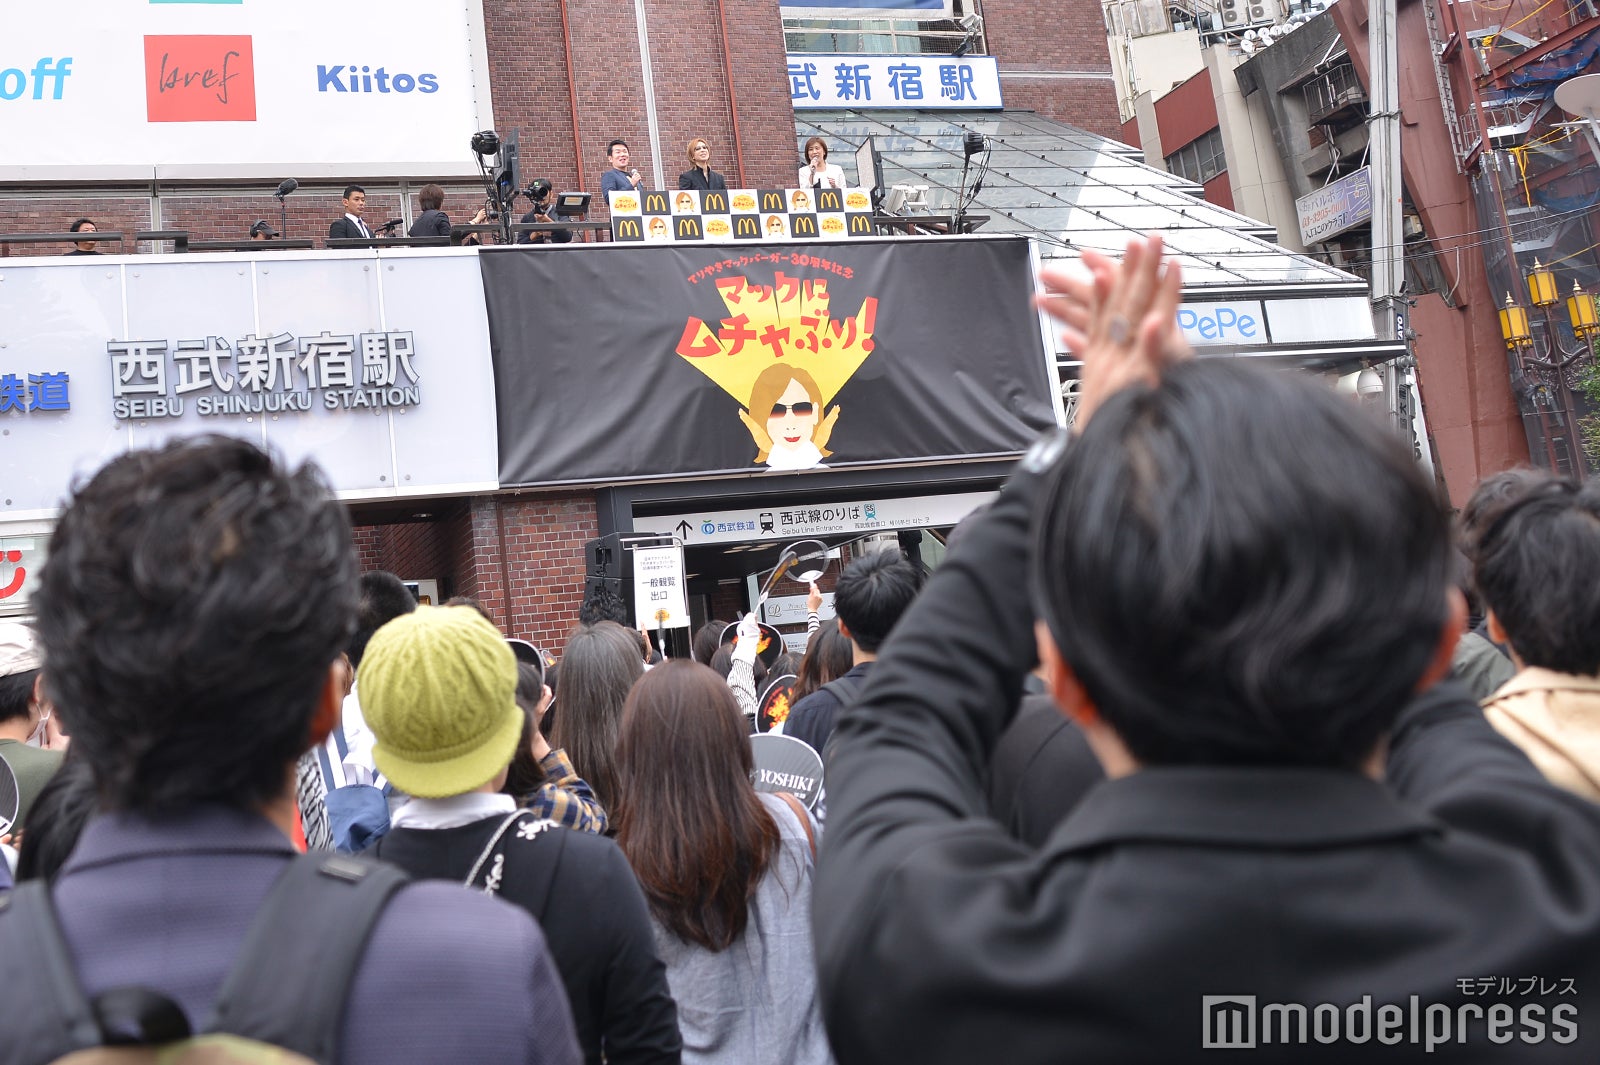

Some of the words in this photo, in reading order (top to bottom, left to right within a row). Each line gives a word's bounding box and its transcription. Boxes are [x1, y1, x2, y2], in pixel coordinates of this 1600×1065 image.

[317, 65, 439, 93] Kiitos
[786, 62, 978, 102] 武新宿駅
[715, 271, 830, 305] マックに
[1176, 307, 1256, 340] PePe
[107, 330, 421, 399] 西武新宿駅
[113, 394, 184, 420] SEIBU
[197, 390, 312, 416] SHINJUKU
[323, 386, 421, 411] STATION
[717, 520, 755, 534] 西武鉄道
[779, 505, 861, 526] 西武線のりば
[642, 576, 676, 588] 一般観覧
[650, 590, 668, 601] 出口
[760, 768, 815, 792] YOSHIKI
